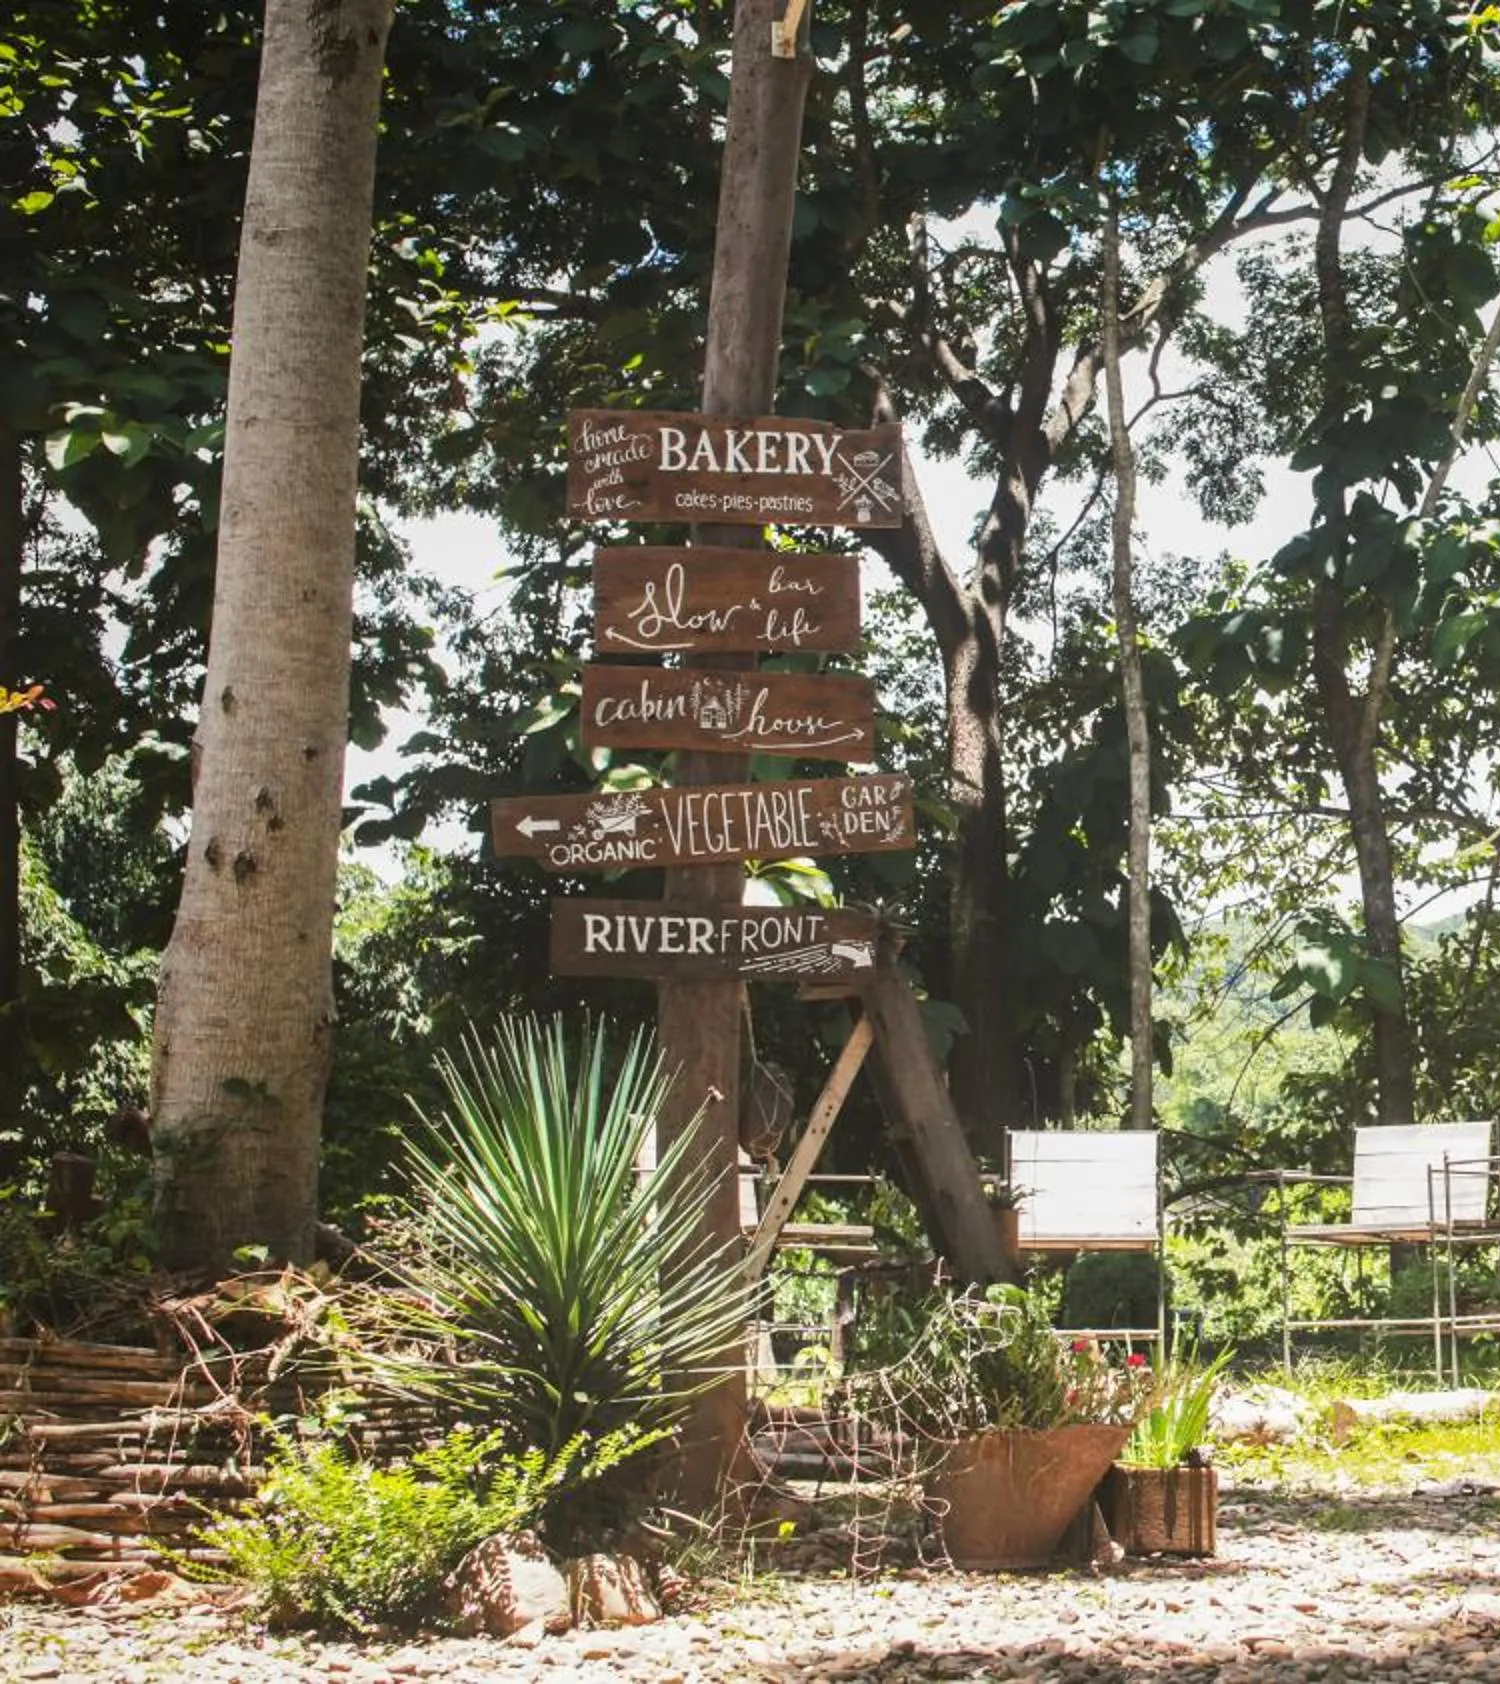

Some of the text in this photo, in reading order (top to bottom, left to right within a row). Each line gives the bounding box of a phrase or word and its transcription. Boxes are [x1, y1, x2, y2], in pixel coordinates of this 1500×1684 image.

[658, 427, 844, 475] BAKERY
[572, 487, 642, 514] love
[627, 563, 825, 638] Slow bar
[756, 607, 822, 646] life
[595, 679, 687, 727] cabin
[721, 687, 843, 738] house
[660, 787, 818, 856] VEGETABLE
[550, 838, 657, 866] ORGANIC
